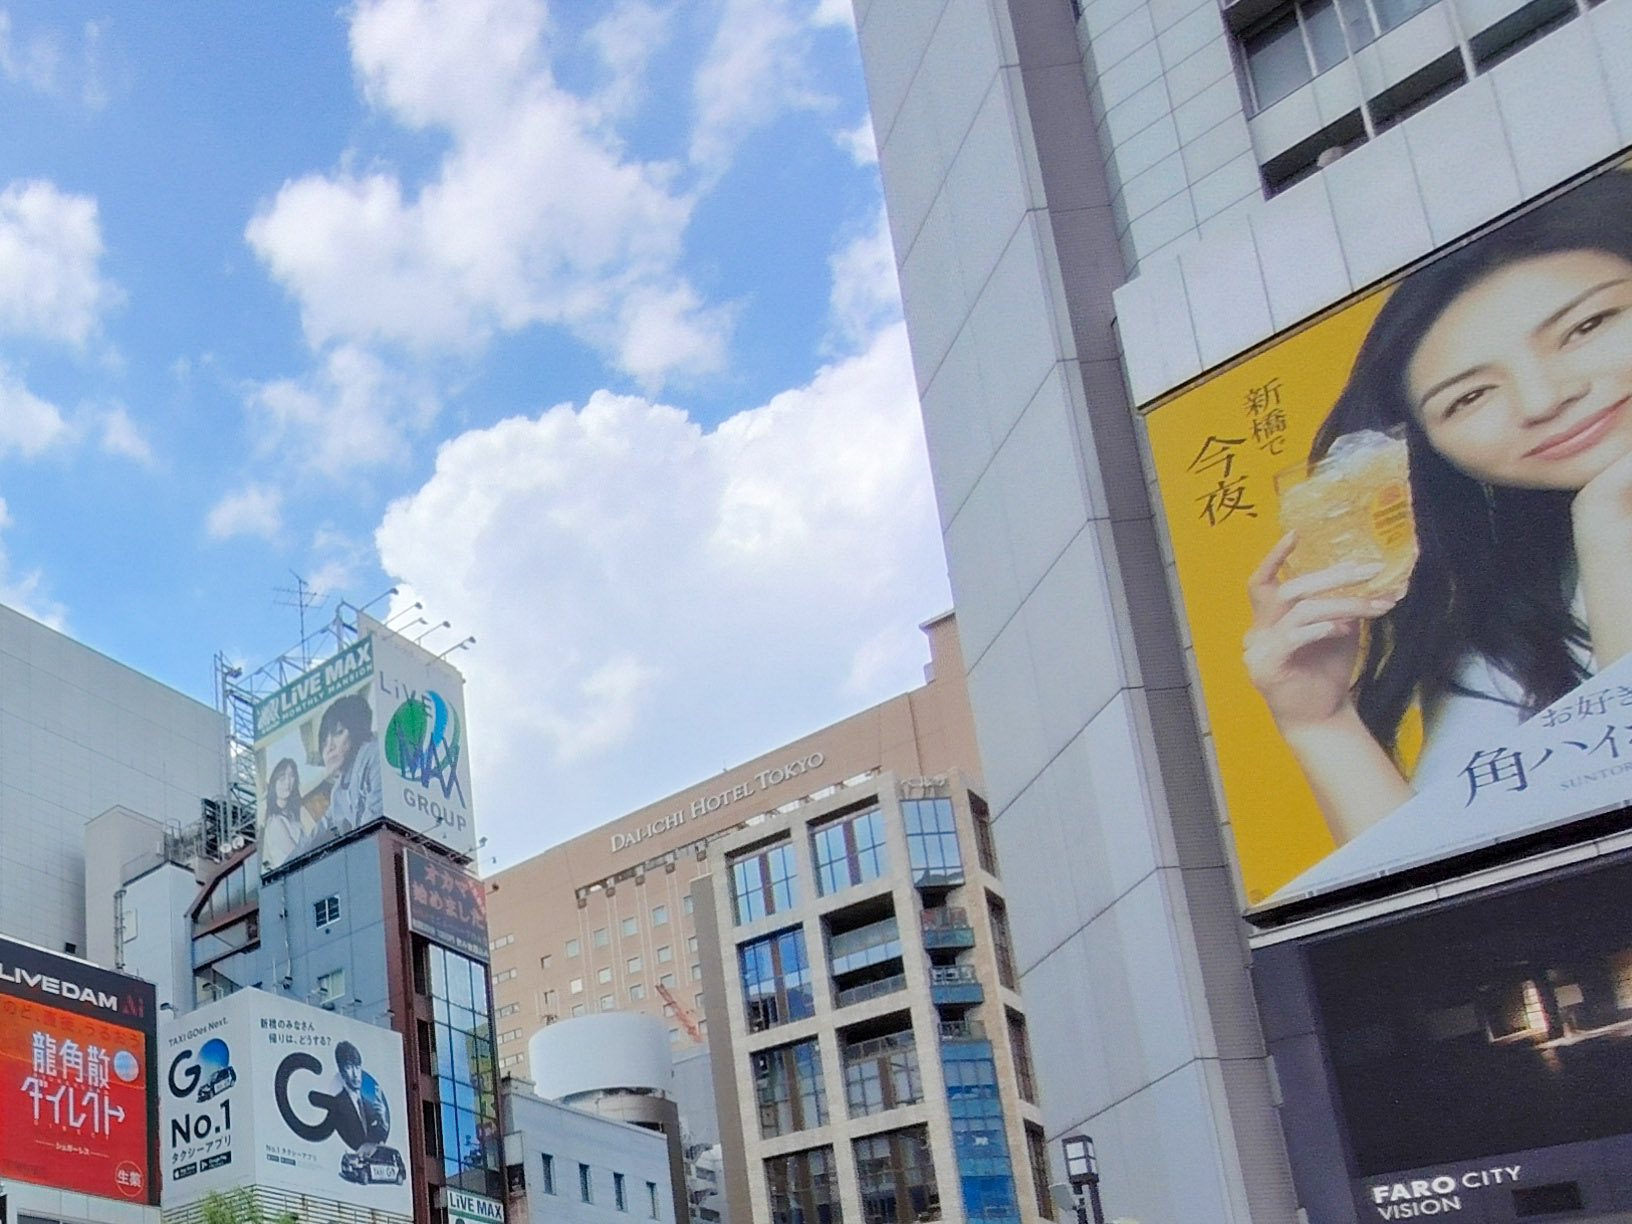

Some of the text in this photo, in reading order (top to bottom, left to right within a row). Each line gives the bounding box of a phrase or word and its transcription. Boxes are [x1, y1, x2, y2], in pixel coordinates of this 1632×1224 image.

[1243, 377, 1287, 455] 新橋で
[324, 642, 371, 686] MAX
[690, 783, 756, 820] HOTEL
[754, 752, 827, 791] TOKYO
[1457, 723, 1632, 808] 角ハイ
[402, 788, 467, 832] GROUP
[260, 1018, 315, 1032] 新橋のみなさん
[32, 1031, 111, 1090] 龍角散
[20, 1076, 126, 1141] ダイレクト
[171, 1099, 231, 1148] No.1
[172, 1134, 231, 1165] タクシーアプリ
[1372, 1165, 1522, 1204] FARO CITY
[476, 1200, 503, 1220] MAX
[1377, 1195, 1463, 1221] VISION
